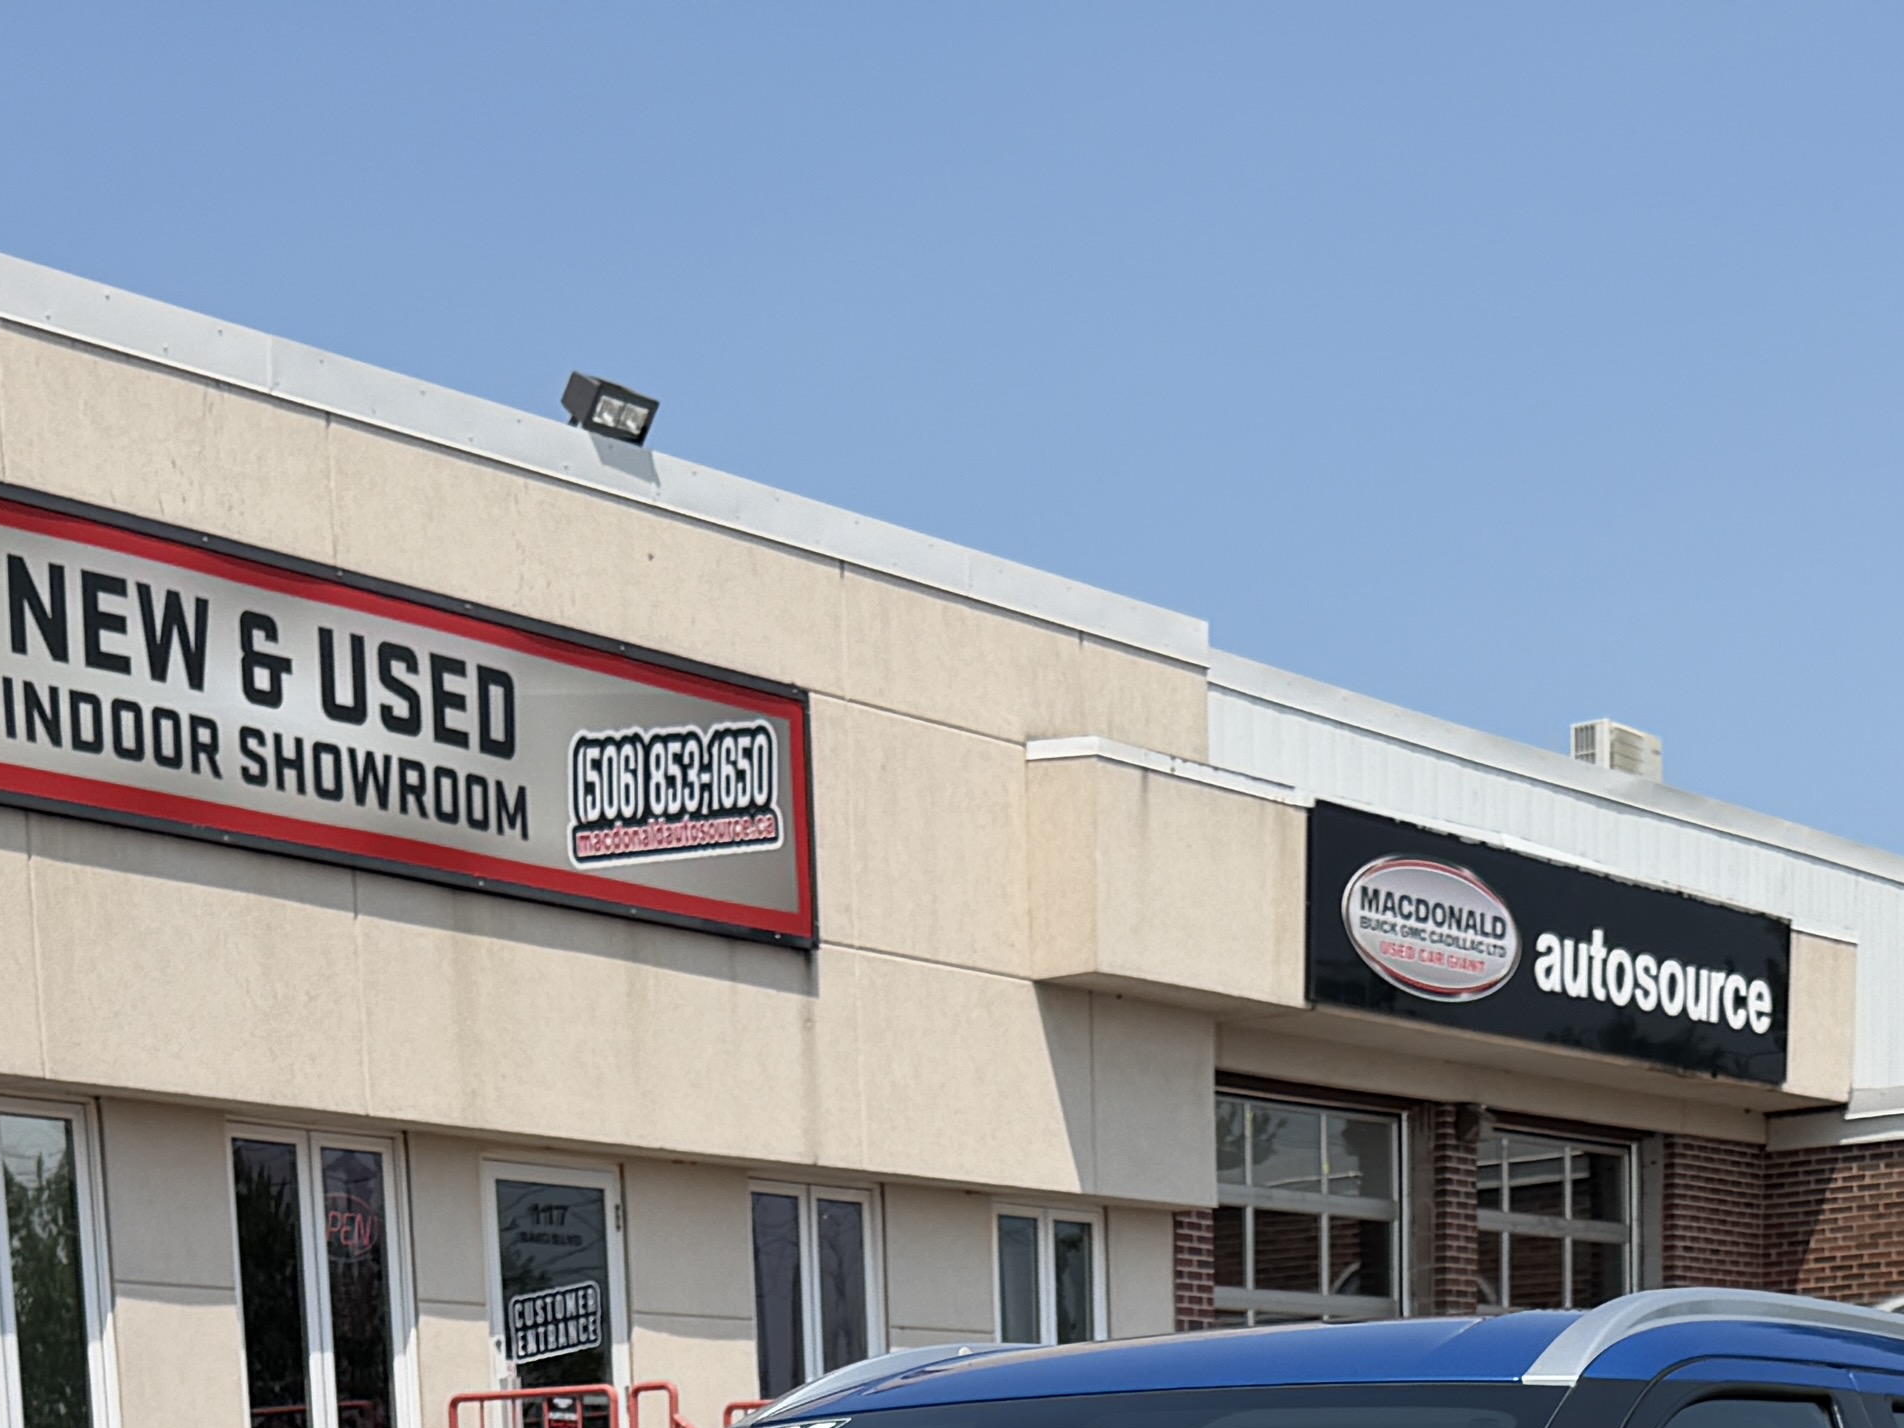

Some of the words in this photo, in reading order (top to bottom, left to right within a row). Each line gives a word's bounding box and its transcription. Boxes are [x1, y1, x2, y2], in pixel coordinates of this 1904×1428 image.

[7, 553, 210, 692] NEW
[240, 610, 293, 709] &
[317, 626, 516, 760] USED
[2, 676, 224, 780] INDOOR
[239, 725, 530, 841] SHOWROOM
[577, 740, 645, 824] (506)
[650, 733, 769, 815] 853-1650
[576, 814, 777, 857] macdonaldautosource.ca
[1359, 916, 1397, 934] BUICK
[1400, 924, 1427, 942] GMC
[1428, 930, 1485, 955] CADILLAC
[1360, 885, 1507, 940] MACDONALD
[1534, 929, 1773, 1034] autosource
[514, 1287, 598, 1329] CUSTOMER
[517, 1316, 597, 1357] ENTRANCE
